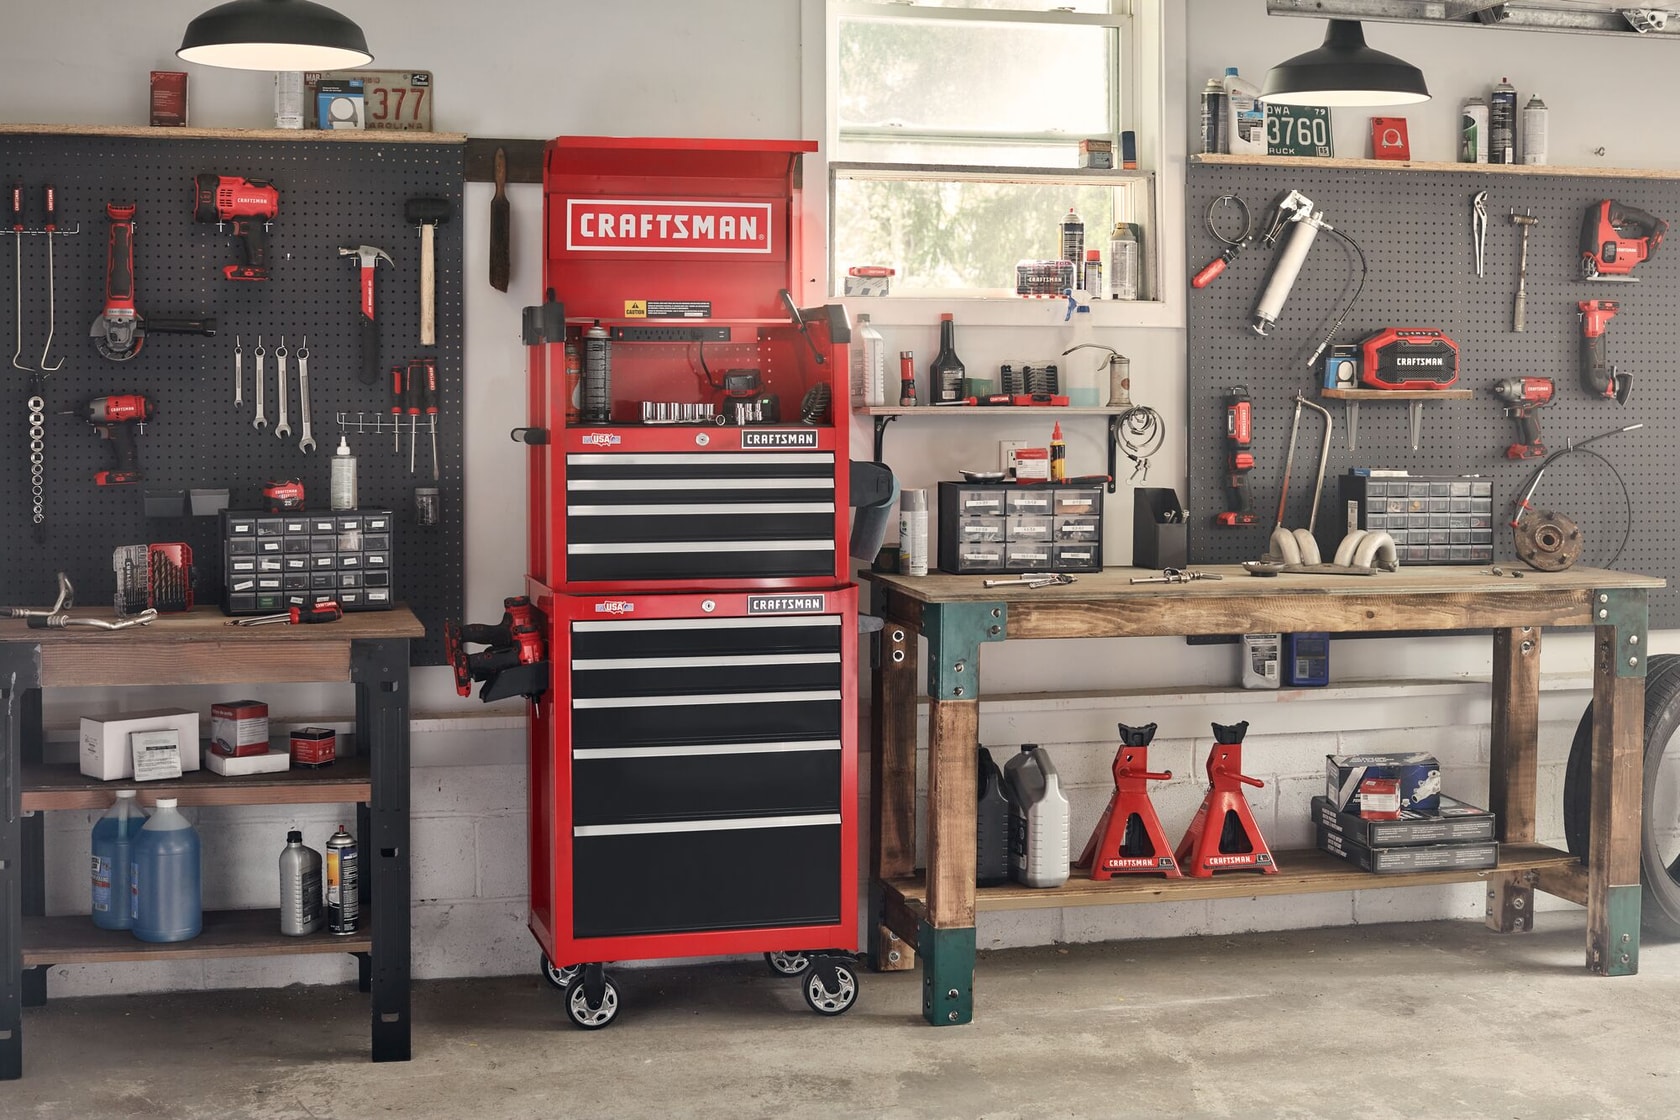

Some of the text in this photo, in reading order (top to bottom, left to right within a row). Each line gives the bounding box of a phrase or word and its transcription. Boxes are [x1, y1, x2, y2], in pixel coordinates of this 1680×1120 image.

[372, 87, 425, 121] 377
[1266, 105, 1290, 115] OWA
[364, 121, 423, 130] AROLINA
[1268, 147, 1295, 155] RUCK
[1396, 357, 1443, 366] CRAFTSMAN
[592, 435, 610, 443] USA
[746, 434, 813, 444] CRAFTSMAN
[606, 602, 623, 611] USA
[753, 598, 820, 610] CRAFTSMAN
[1109, 859, 1153, 867] CRAFTSMAN
[1209, 856, 1251, 865] CRAFTSMAN
